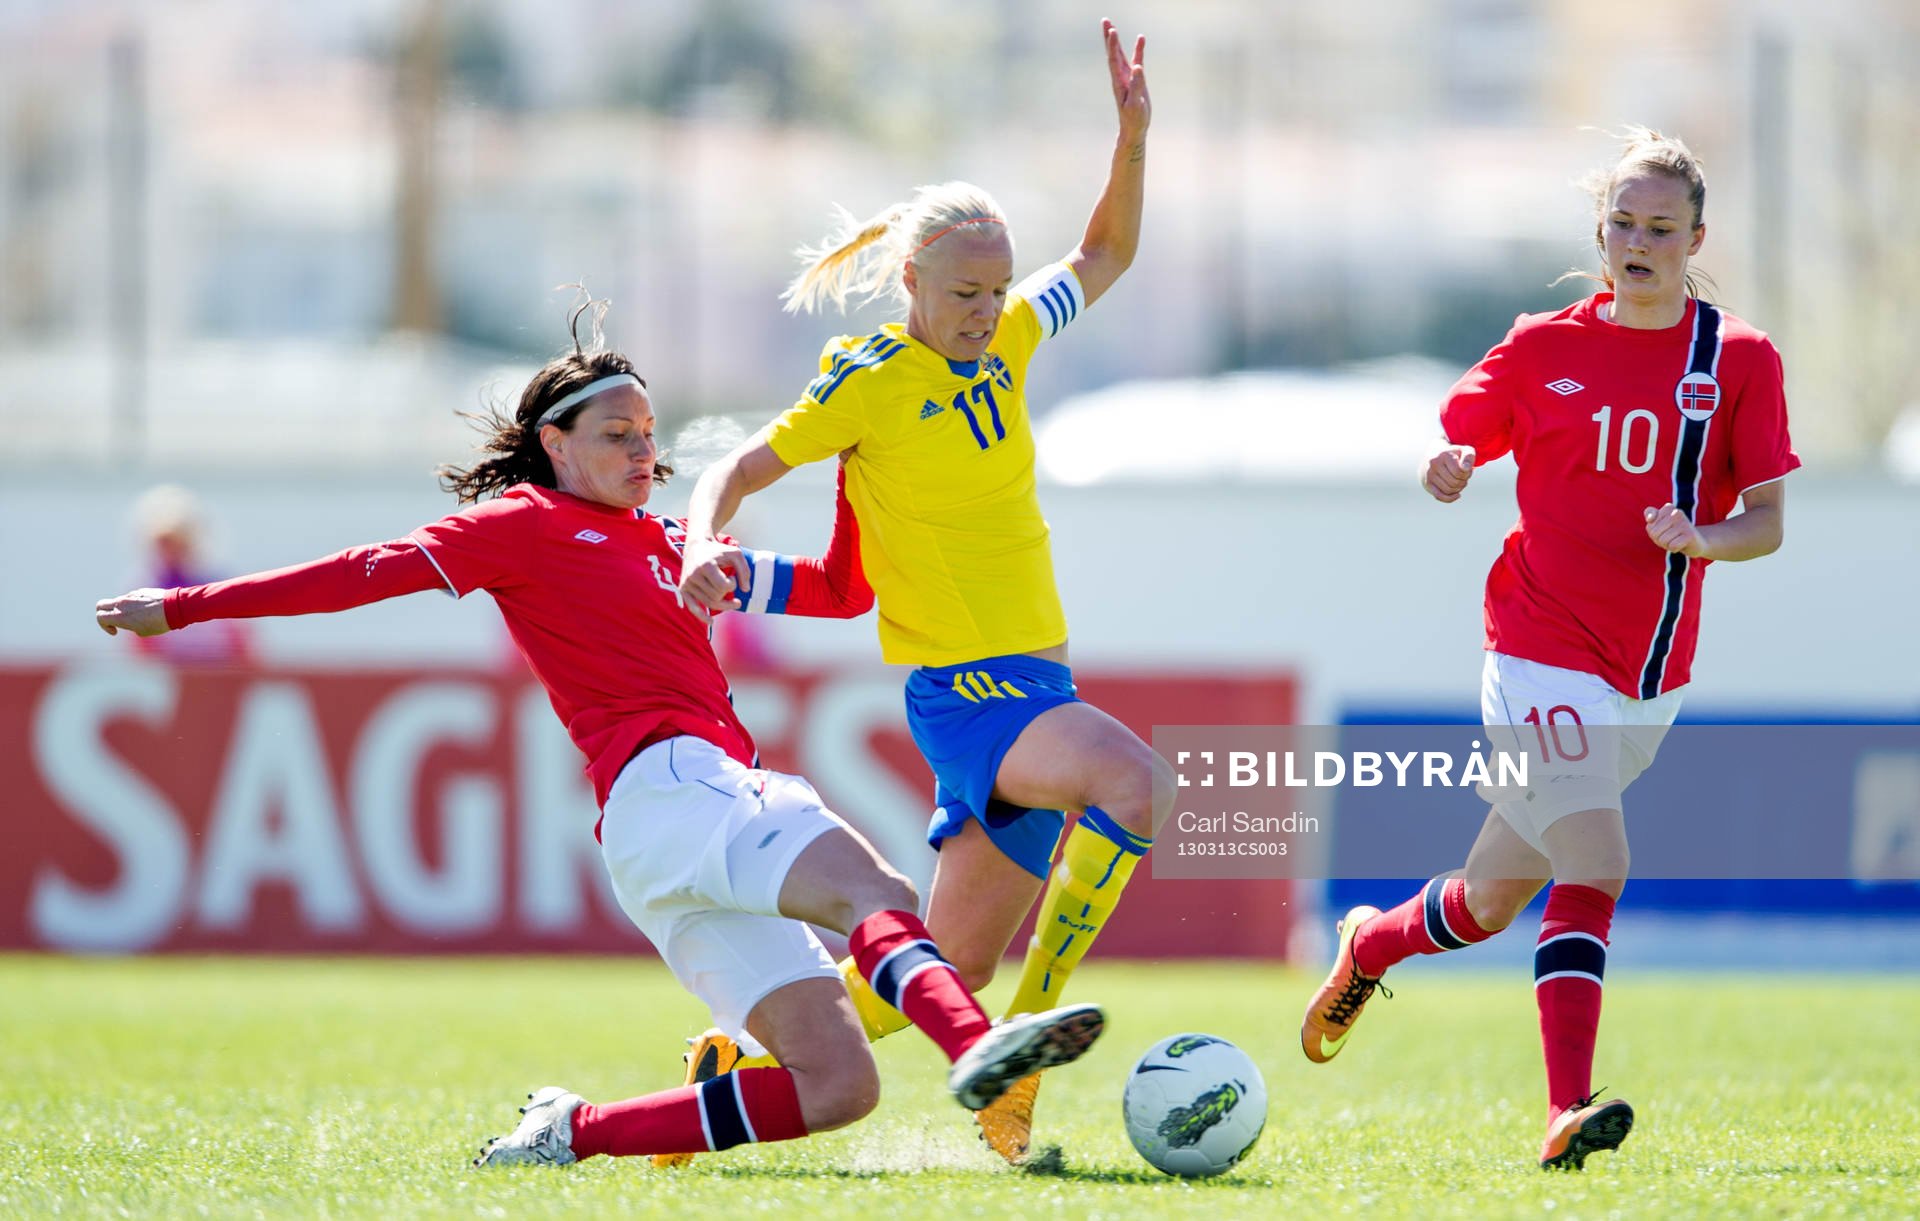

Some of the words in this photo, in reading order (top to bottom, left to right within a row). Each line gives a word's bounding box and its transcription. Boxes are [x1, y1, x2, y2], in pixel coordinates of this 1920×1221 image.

[952, 378, 1006, 451] 17
[1592, 405, 1659, 474] 10
[647, 555, 684, 609] 4
[1524, 704, 1589, 763] 10
